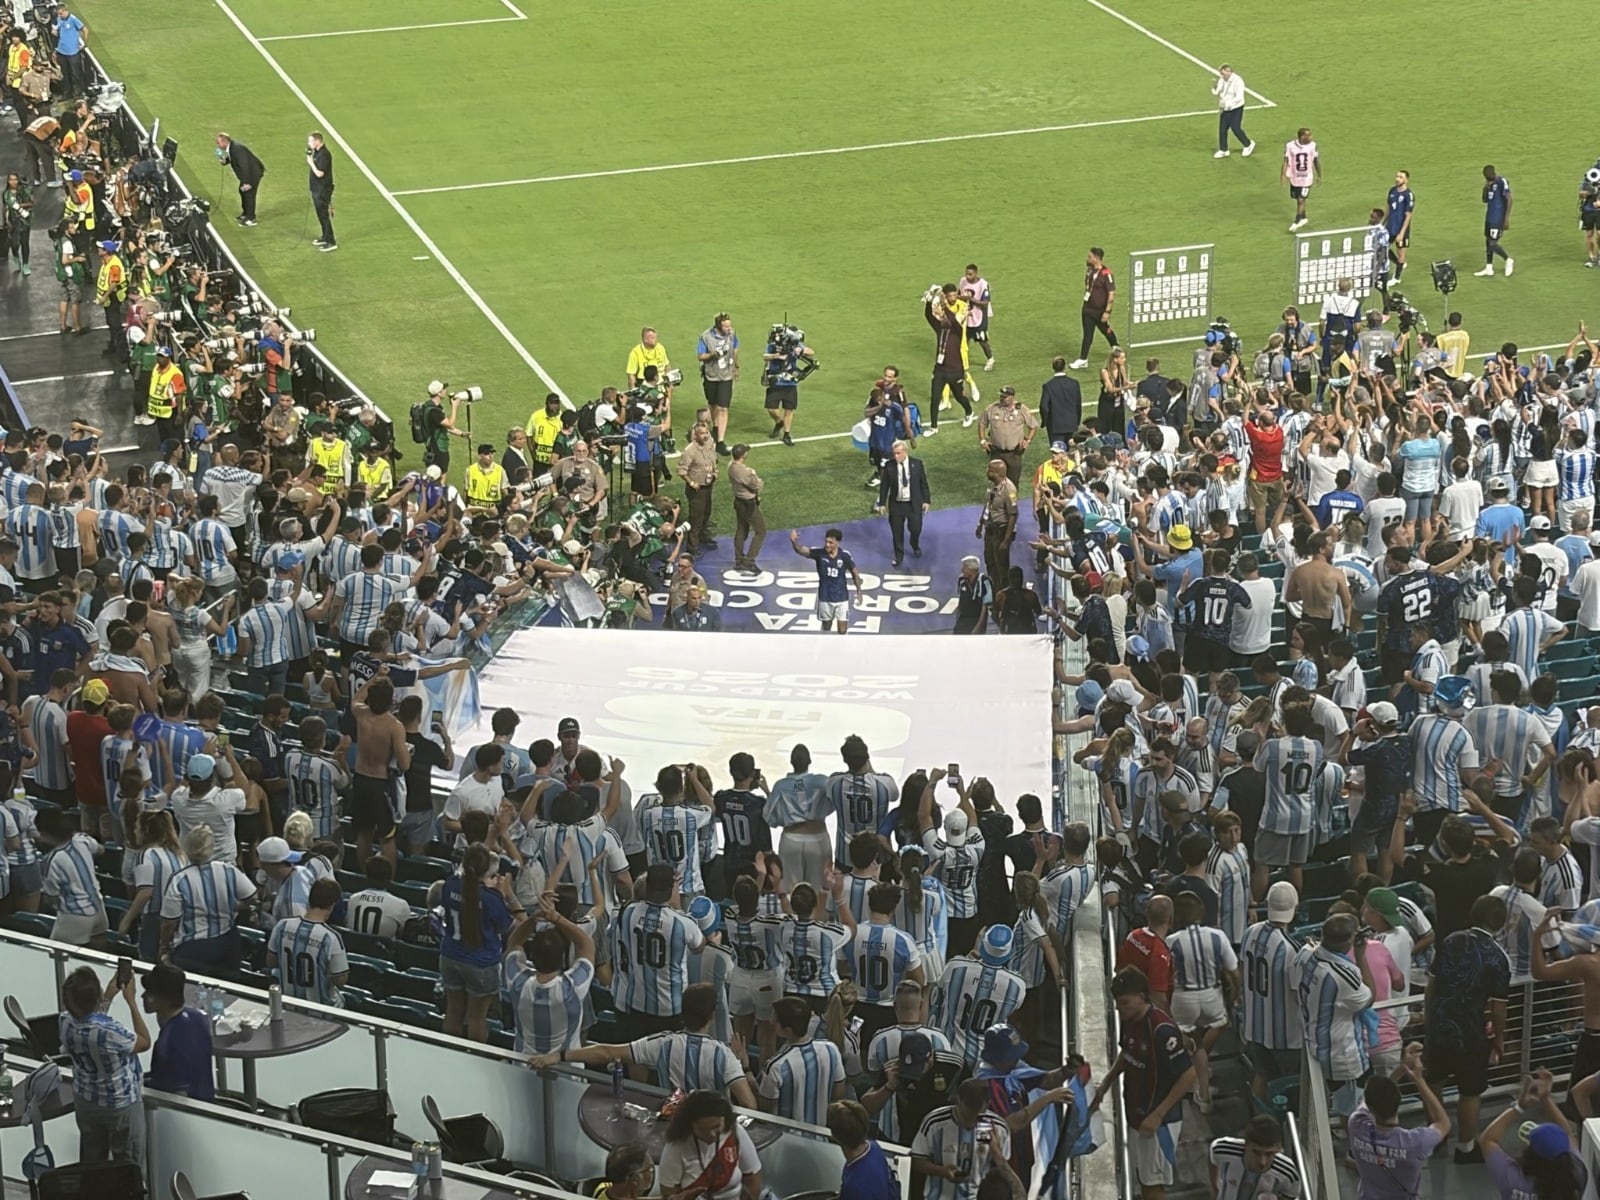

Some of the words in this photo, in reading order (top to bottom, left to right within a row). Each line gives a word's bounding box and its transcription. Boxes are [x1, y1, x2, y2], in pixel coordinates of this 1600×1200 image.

[1088, 545, 1109, 575] 10
[1203, 597, 1228, 625] 10
[1402, 588, 1432, 622] 22
[350, 661, 374, 679] MESSI
[625, 666, 919, 689] 2026
[618, 680, 720, 694] CUP
[730, 687, 915, 701] WORLD
[690, 704, 822, 722] FIFA
[290, 774, 318, 808] 10
[1281, 763, 1313, 795] 10
[846, 793, 873, 824] 10
[722, 813, 751, 846] 10
[654, 830, 686, 863] 10
[360, 894, 384, 904] MESSI
[354, 905, 383, 935] 10
[633, 926, 667, 969] 10
[861, 940, 888, 952] MESSI
[283, 947, 315, 988] 10
[858, 954, 890, 992] 10
[1246, 950, 1269, 998] 10
[960, 993, 998, 1036] 10
[1388, 1147, 1408, 1161] FAN
